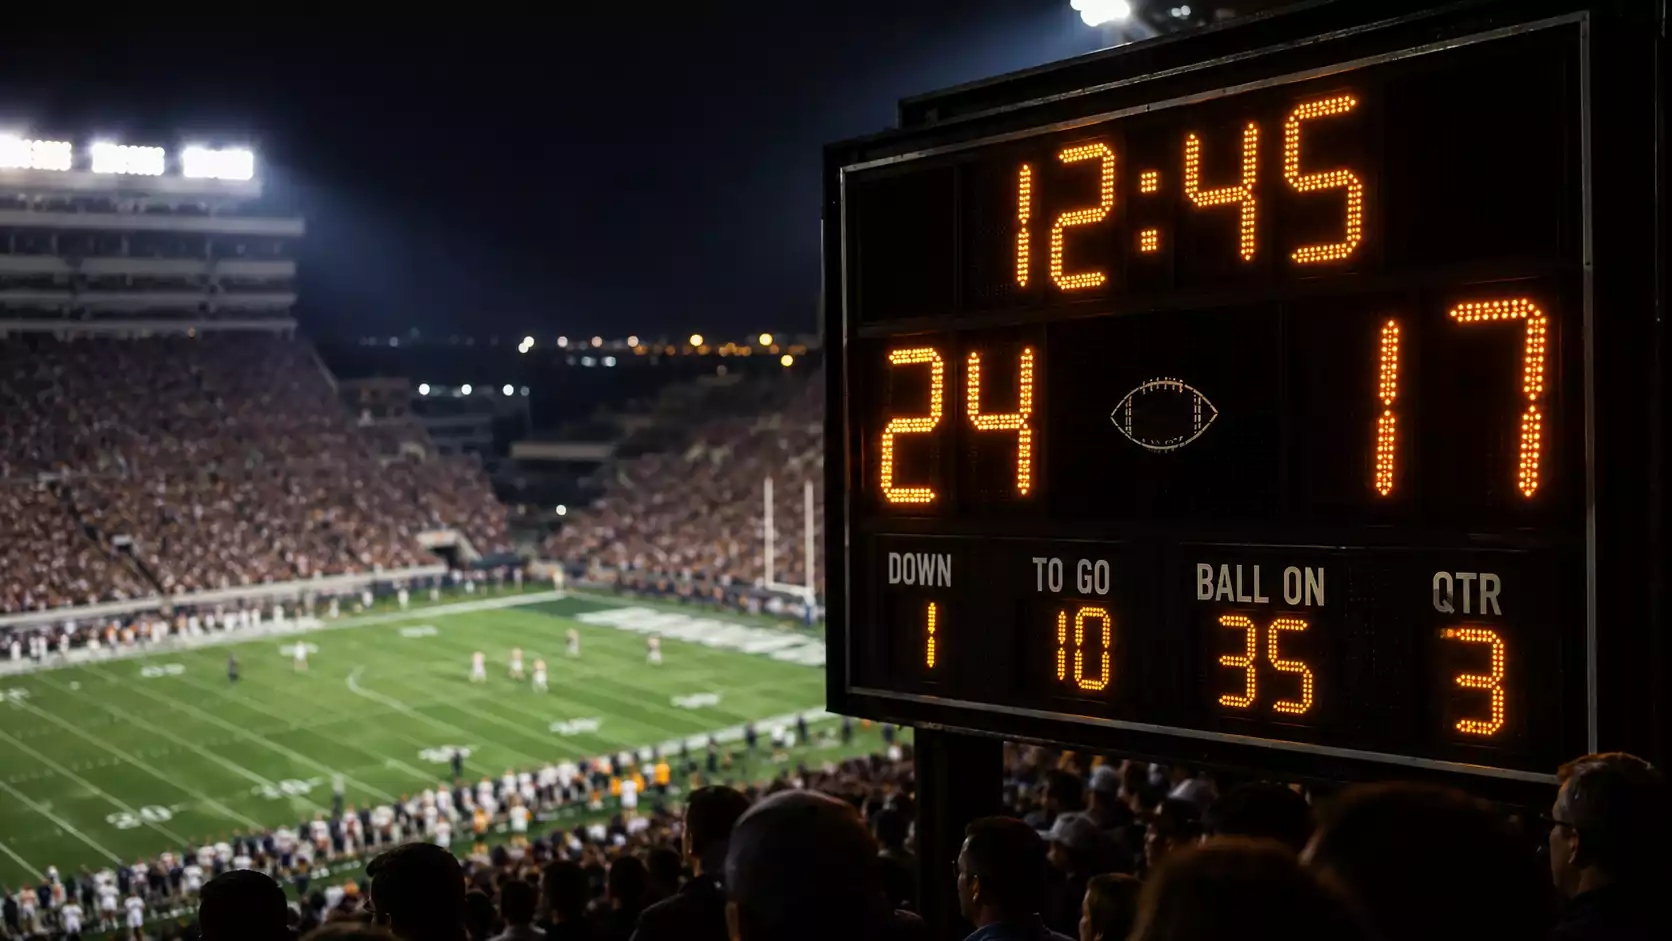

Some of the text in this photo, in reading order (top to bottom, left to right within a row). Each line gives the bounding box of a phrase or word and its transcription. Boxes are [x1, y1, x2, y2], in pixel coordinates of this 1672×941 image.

[1016, 94, 1364, 291] 12:45
[879, 347, 1035, 504] 24
[1374, 297, 1550, 498] 17
[888, 552, 952, 588] DOWN
[1032, 556, 1111, 595] TO GO
[1197, 563, 1326, 607] BALL ON
[1432, 571, 1502, 616] QTR
[924, 601, 938, 669] 1
[1056, 605, 1112, 691] 10
[1218, 614, 1314, 715] 35
[1454, 627, 1505, 736] 3
